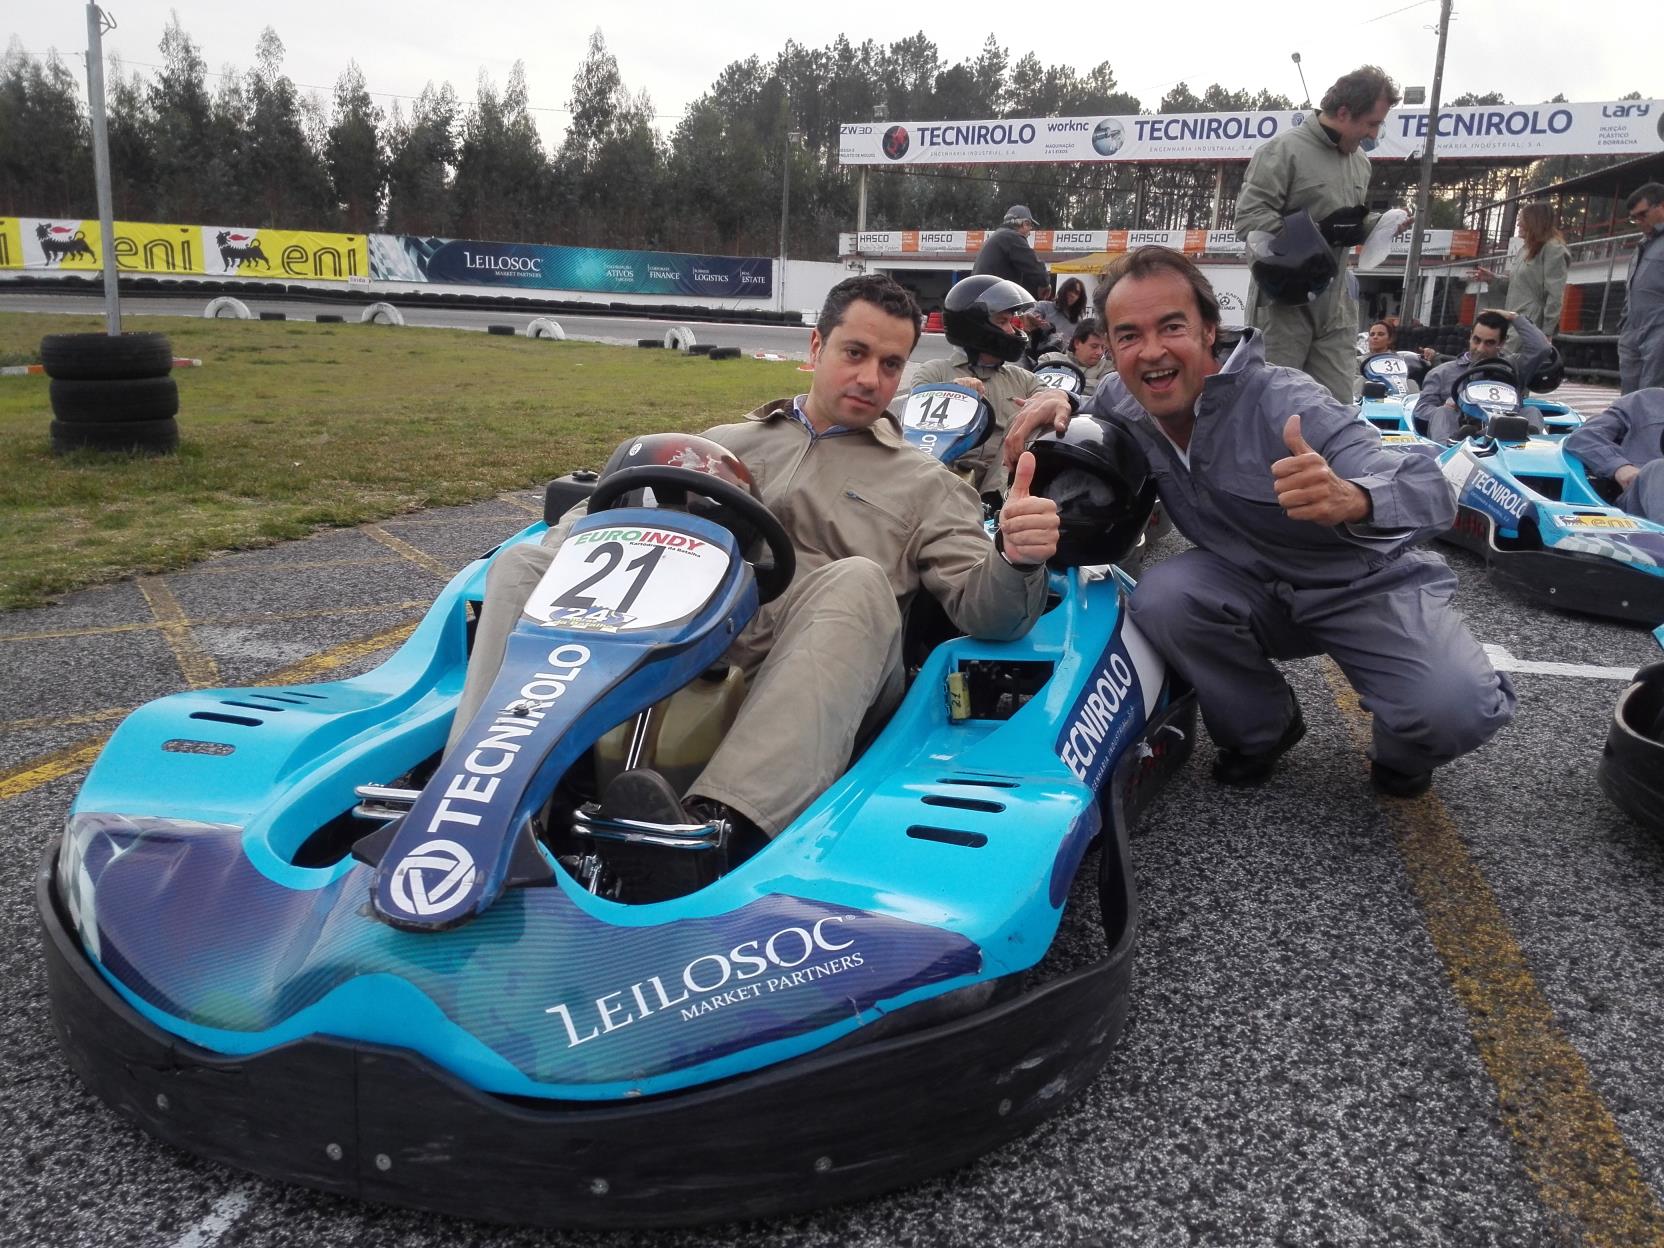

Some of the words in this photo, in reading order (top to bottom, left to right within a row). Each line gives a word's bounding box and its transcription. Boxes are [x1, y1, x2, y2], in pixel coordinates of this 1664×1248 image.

[1047, 120, 1090, 132] worknc
[1134, 116, 1278, 141] TECNIROLO
[1398, 109, 1573, 137] TECNIROLO
[917, 123, 1036, 147] TECNIROLO
[859, 234, 890, 243] HASCO
[921, 233, 953, 243] HASCO
[1056, 233, 1093, 243] HASCO
[1130, 233, 1170, 243] HASCO
[114, 228, 193, 271] eni
[281, 237, 356, 277] eni
[464, 251, 541, 271] LEILOSOC
[606, 269, 634, 278] ATIVOS
[649, 270, 680, 280] FINANCE
[694, 273, 729, 282] LOGISTICS
[742, 275, 766, 284] ESTATE
[1384, 360, 1401, 372] 31
[1043, 375, 1064, 388] 24
[1489, 388, 1501, 401] 8
[920, 395, 951, 425] 14
[574, 530, 706, 551] EUROINDY
[550, 541, 667, 614] 21
[1060, 653, 1133, 782] ECNIROLO
[427, 644, 591, 833] TECNIROLO
[545, 915, 856, 1048] LEILOSOC
[680, 983, 764, 1022] MARKET
[768, 951, 865, 993] PARTNERS
